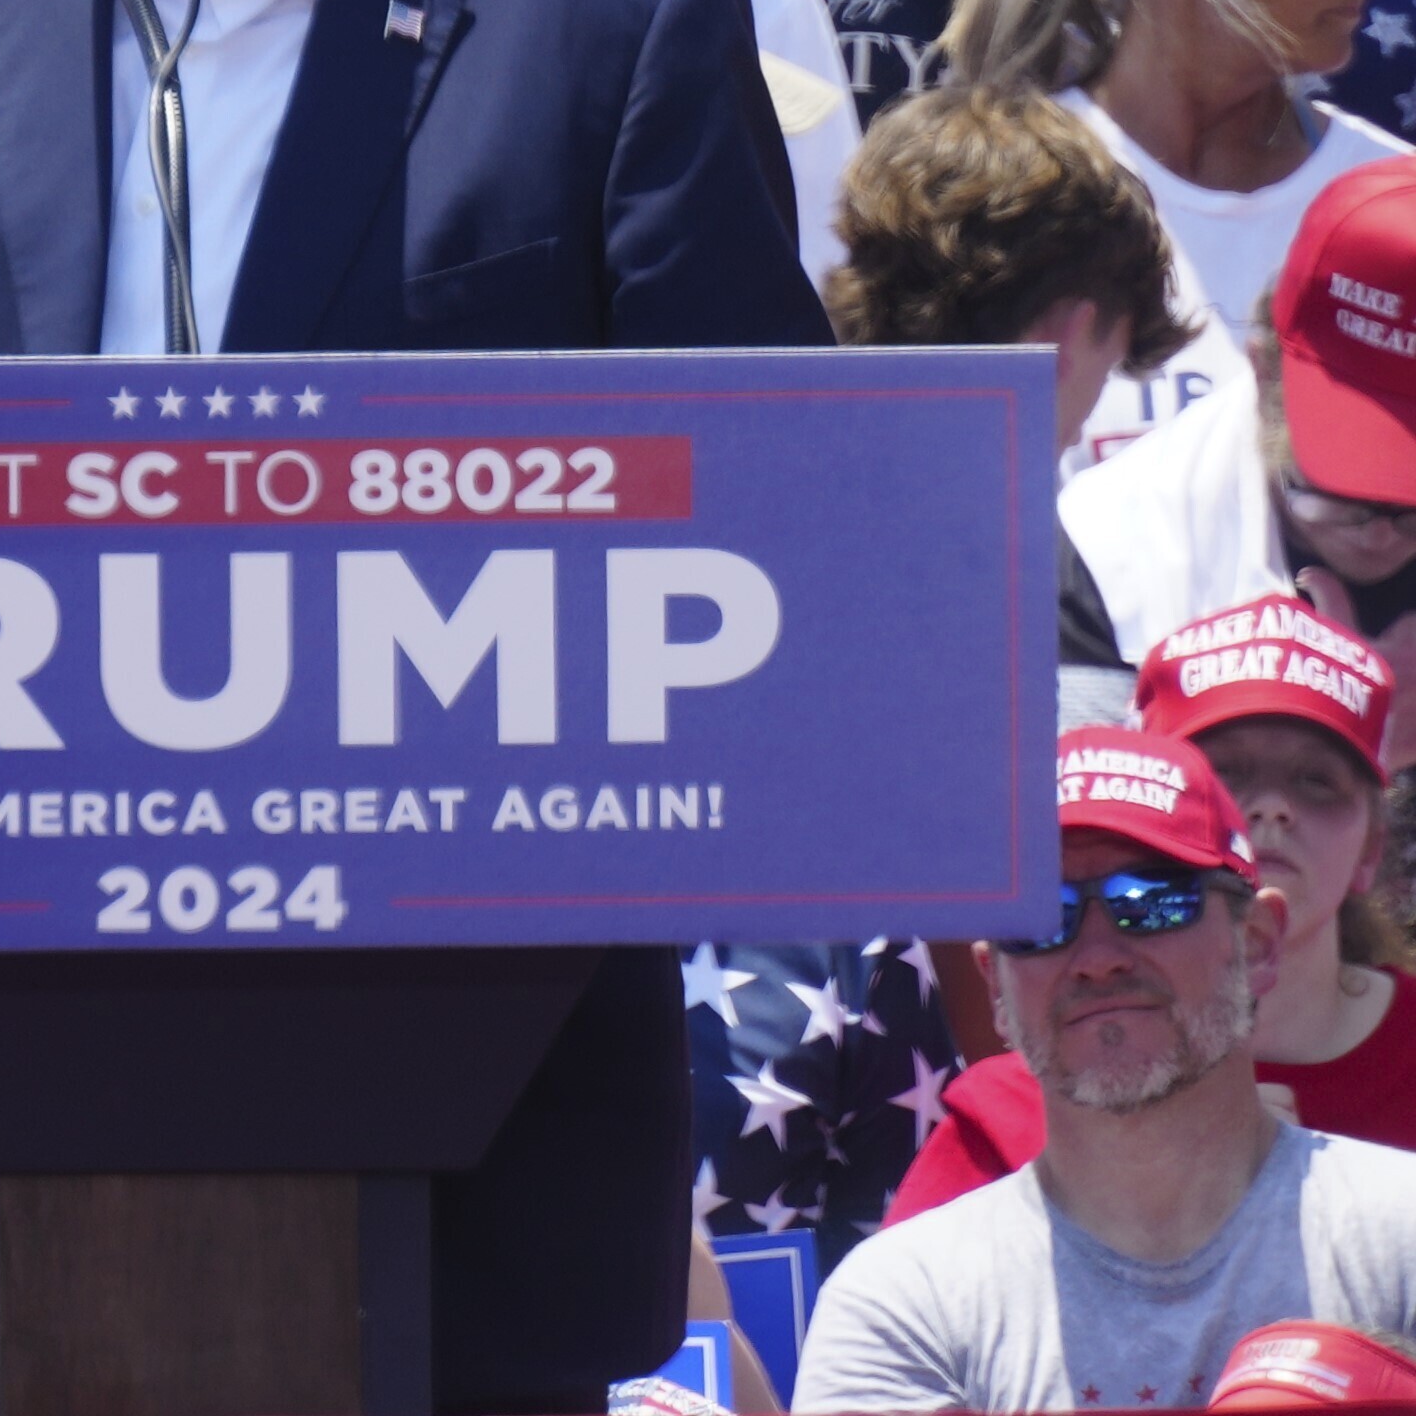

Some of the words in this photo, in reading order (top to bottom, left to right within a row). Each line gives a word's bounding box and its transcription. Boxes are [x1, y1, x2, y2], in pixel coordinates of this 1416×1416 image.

[1327, 272, 1404, 319] MAKE
[64, 450, 179, 517] SC
[207, 449, 321, 516] TO
[348, 445, 617, 515] 88022
[1162, 609, 1256, 661] MAKE
[1255, 604, 1386, 686] AMERICA
[1180, 645, 1284, 699] GREAT
[1282, 650, 1374, 720] AGAIN
[1062, 746, 1187, 792] AMERICA
[1088, 777, 1180, 815] AGAIN
[252, 788, 469, 836] GREAT
[492, 785, 724, 833] AGAIN!
[97, 867, 348, 934] 2024
